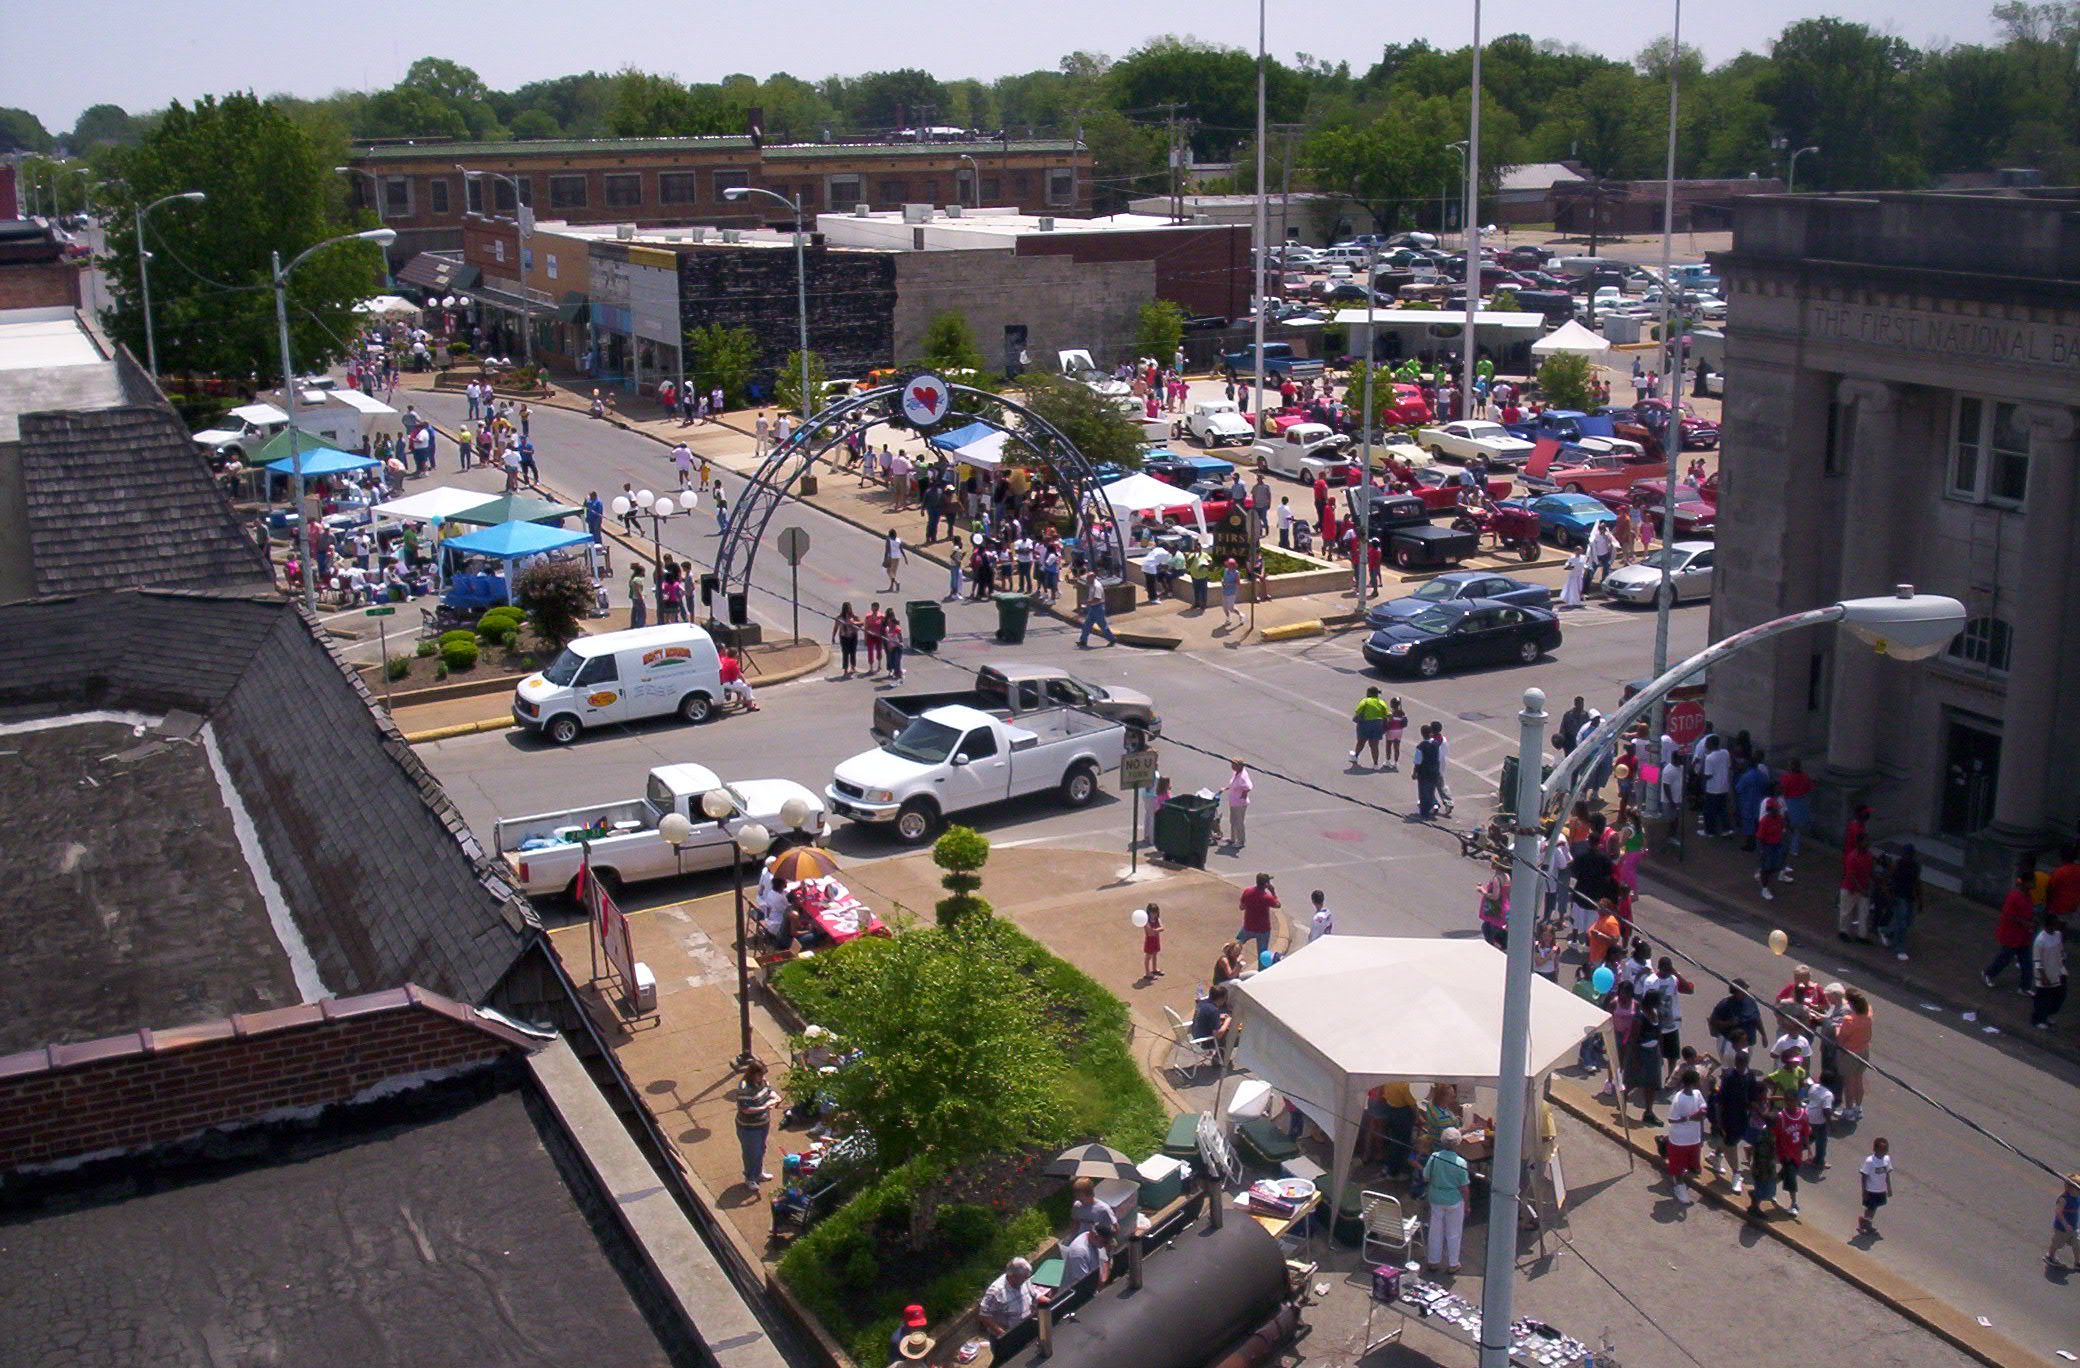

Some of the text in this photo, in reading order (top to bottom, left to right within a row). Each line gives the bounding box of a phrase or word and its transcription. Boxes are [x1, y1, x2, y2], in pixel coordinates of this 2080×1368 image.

[1815, 307, 1850, 338] THE
[1860, 312, 1920, 346] FIRST
[1928, 320, 2042, 361] NATIONAL
[1217, 533, 1247, 543] FIRS
[1216, 545, 1249, 555] PLAZ
[1670, 714, 1703, 733] STOP
[1126, 758, 1153, 770] NO U
[1792, 1131, 1800, 1144] 3
